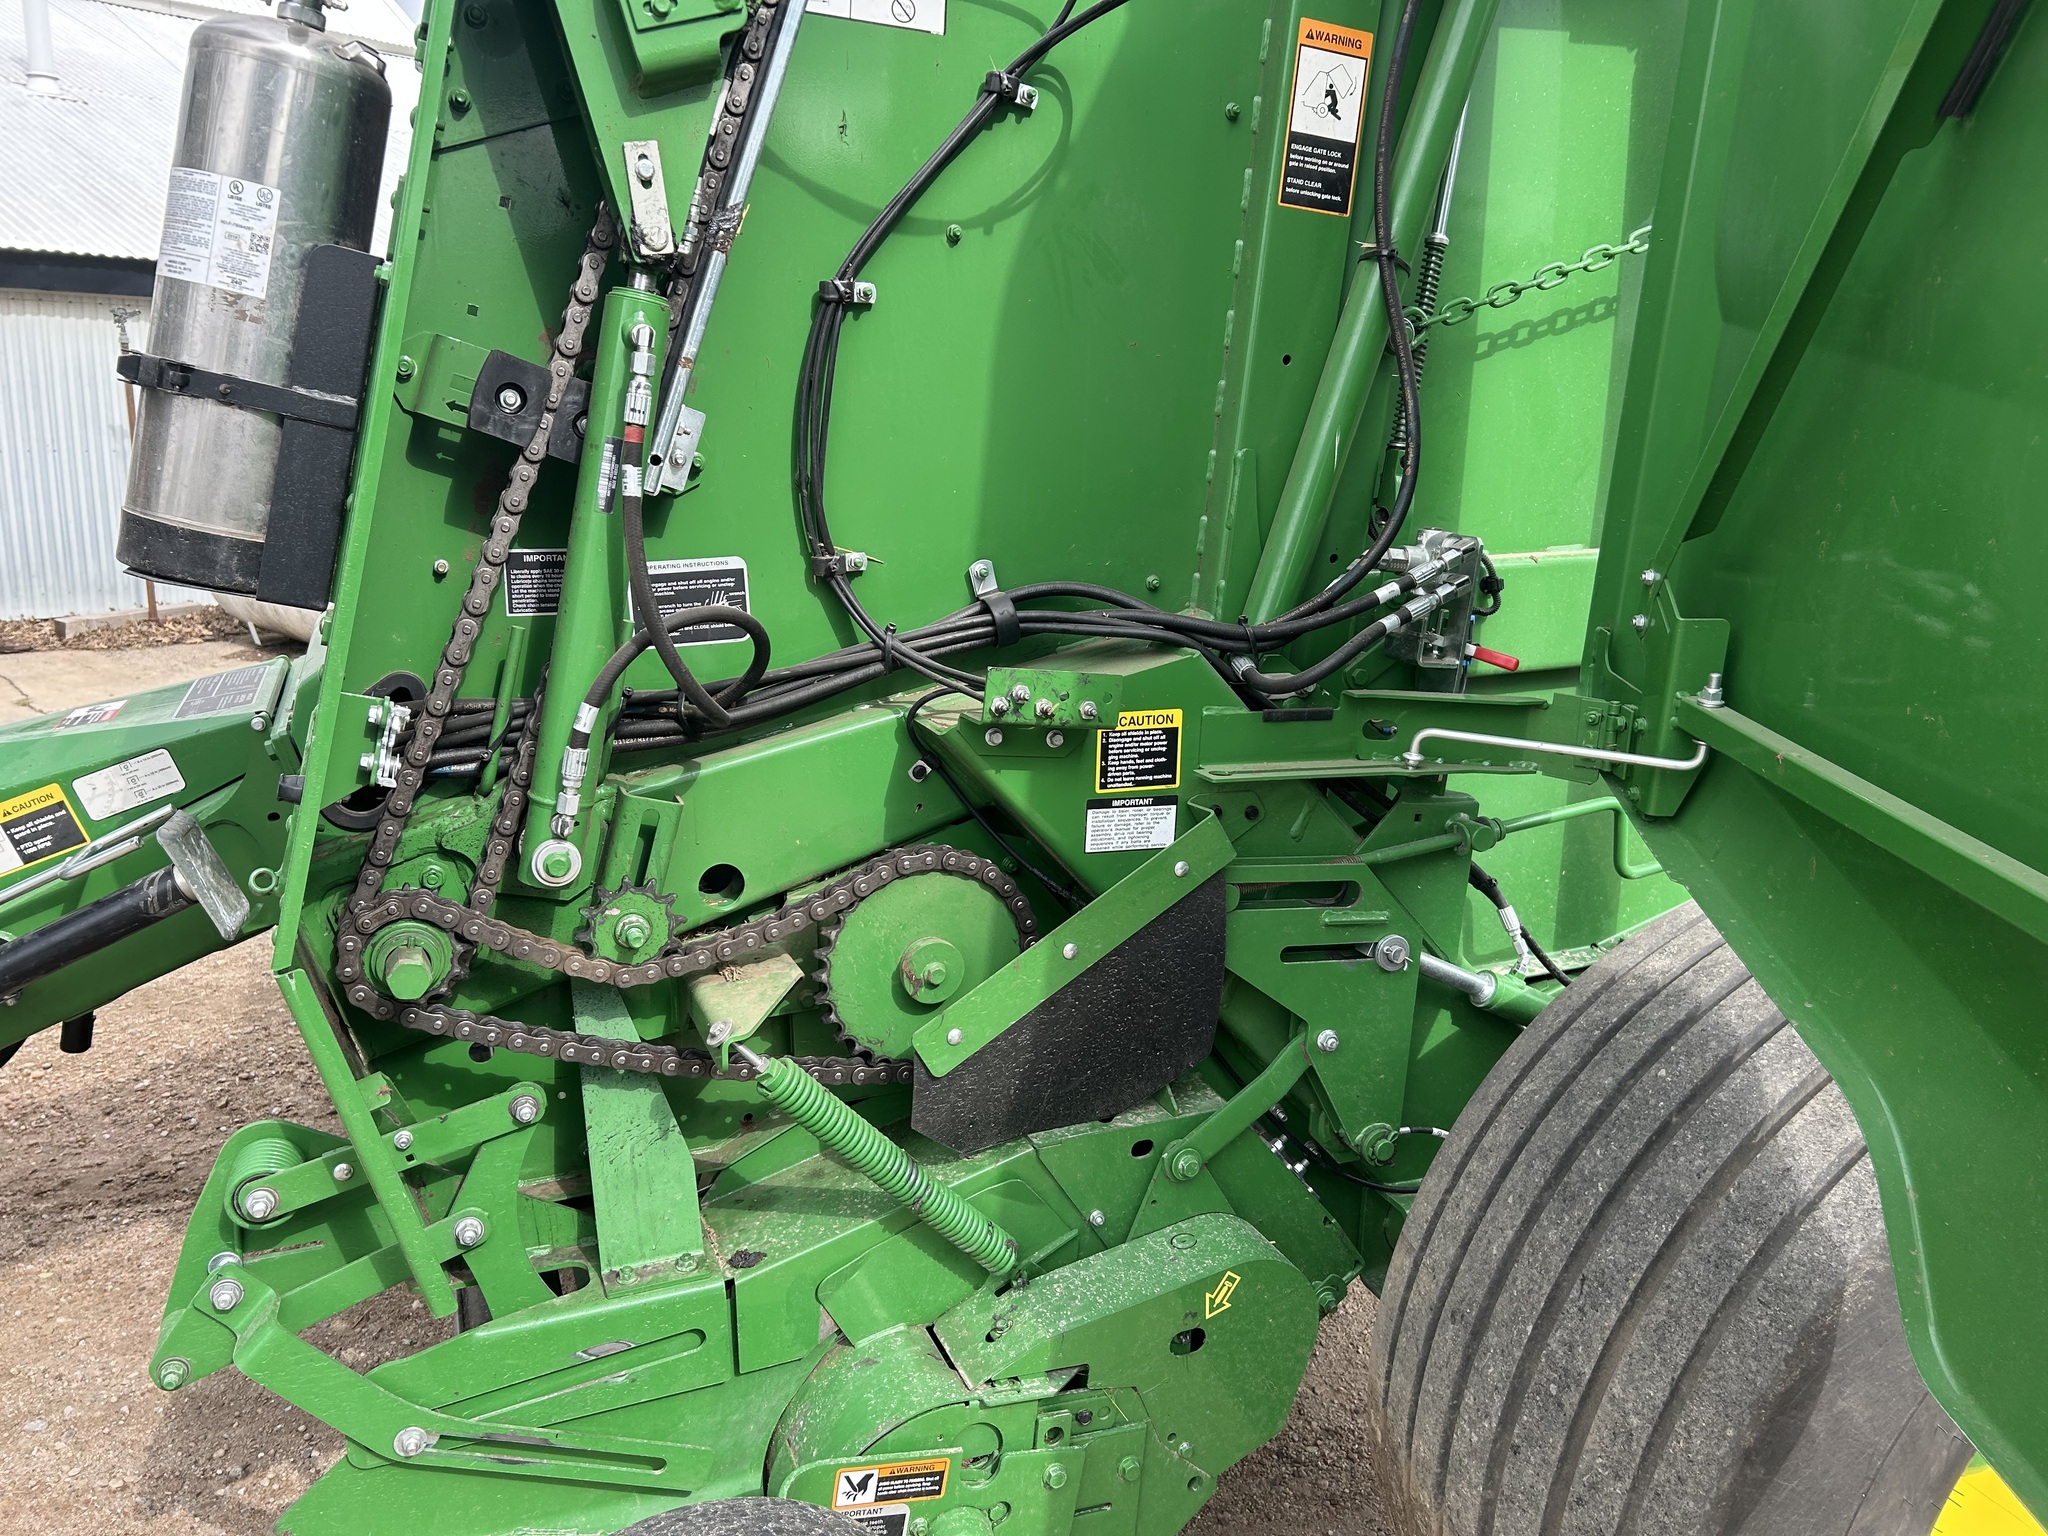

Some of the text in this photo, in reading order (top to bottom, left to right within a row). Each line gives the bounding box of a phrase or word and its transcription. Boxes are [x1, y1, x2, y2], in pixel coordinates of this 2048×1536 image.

[1315, 30, 1362, 49] WARNING
[1291, 144, 1342, 158] ENGAGE GATE LOCK
[1289, 160, 1298, 168] gate
[1318, 165, 1336, 174] position.
[1290, 153, 1303, 161] before
[1305, 155, 1320, 164] working
[1334, 159, 1349, 169] around
[232, 182, 240, 192] UL
[1287, 177, 1322, 188] STAND CLEAR
[260, 191, 270, 200] ULC
[1301, 188, 1320, 199] unlocking
[683, 560, 728, 568] INSTRUCTIONS
[1119, 714, 1174, 726] CAUTION
[12, 793, 54, 813] CAUTION
[1112, 798, 1153, 806] IMPORTANT
[10, 825, 26, 834] Keep
[34, 815, 55, 825] shields
[55, 809, 66, 817] and
[14, 829, 31, 839] guard
[38, 821, 55, 831] place.
[20, 835, 53, 850] PTO speed:
[23, 841, 52, 855] 1000 RPM
[896, 1465, 935, 1474] WARNING
[841, 1508, 883, 1517] PORTANT
